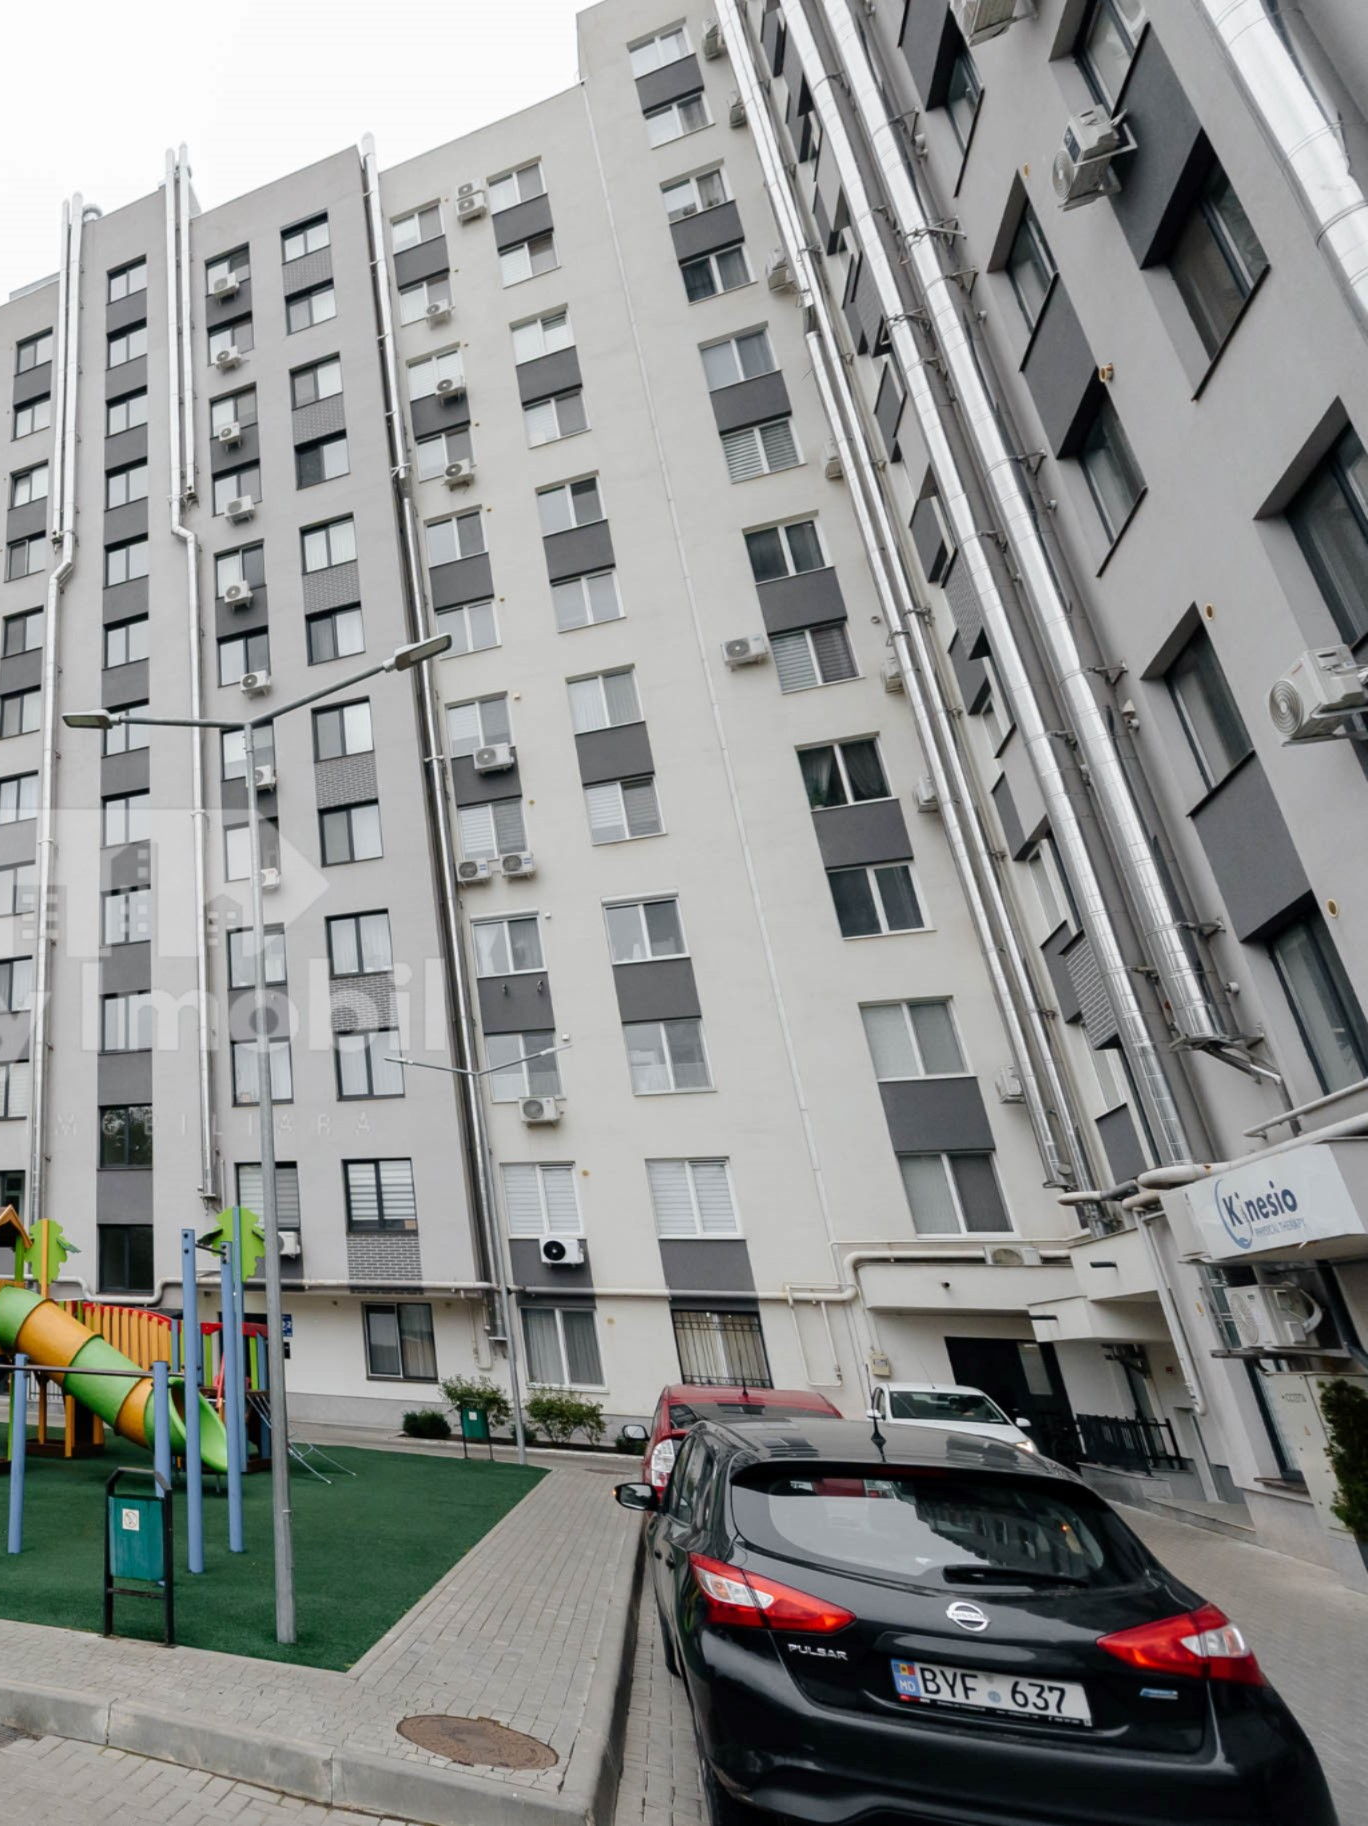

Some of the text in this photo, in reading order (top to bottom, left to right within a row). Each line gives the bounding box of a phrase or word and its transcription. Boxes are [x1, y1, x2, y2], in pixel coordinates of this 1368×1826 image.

[1222, 1180, 1298, 1227] Kinesio
[787, 1643, 849, 1661] PULSAR
[900, 1679, 916, 1692] MD
[919, 1666, 1066, 1714] BYF 637
